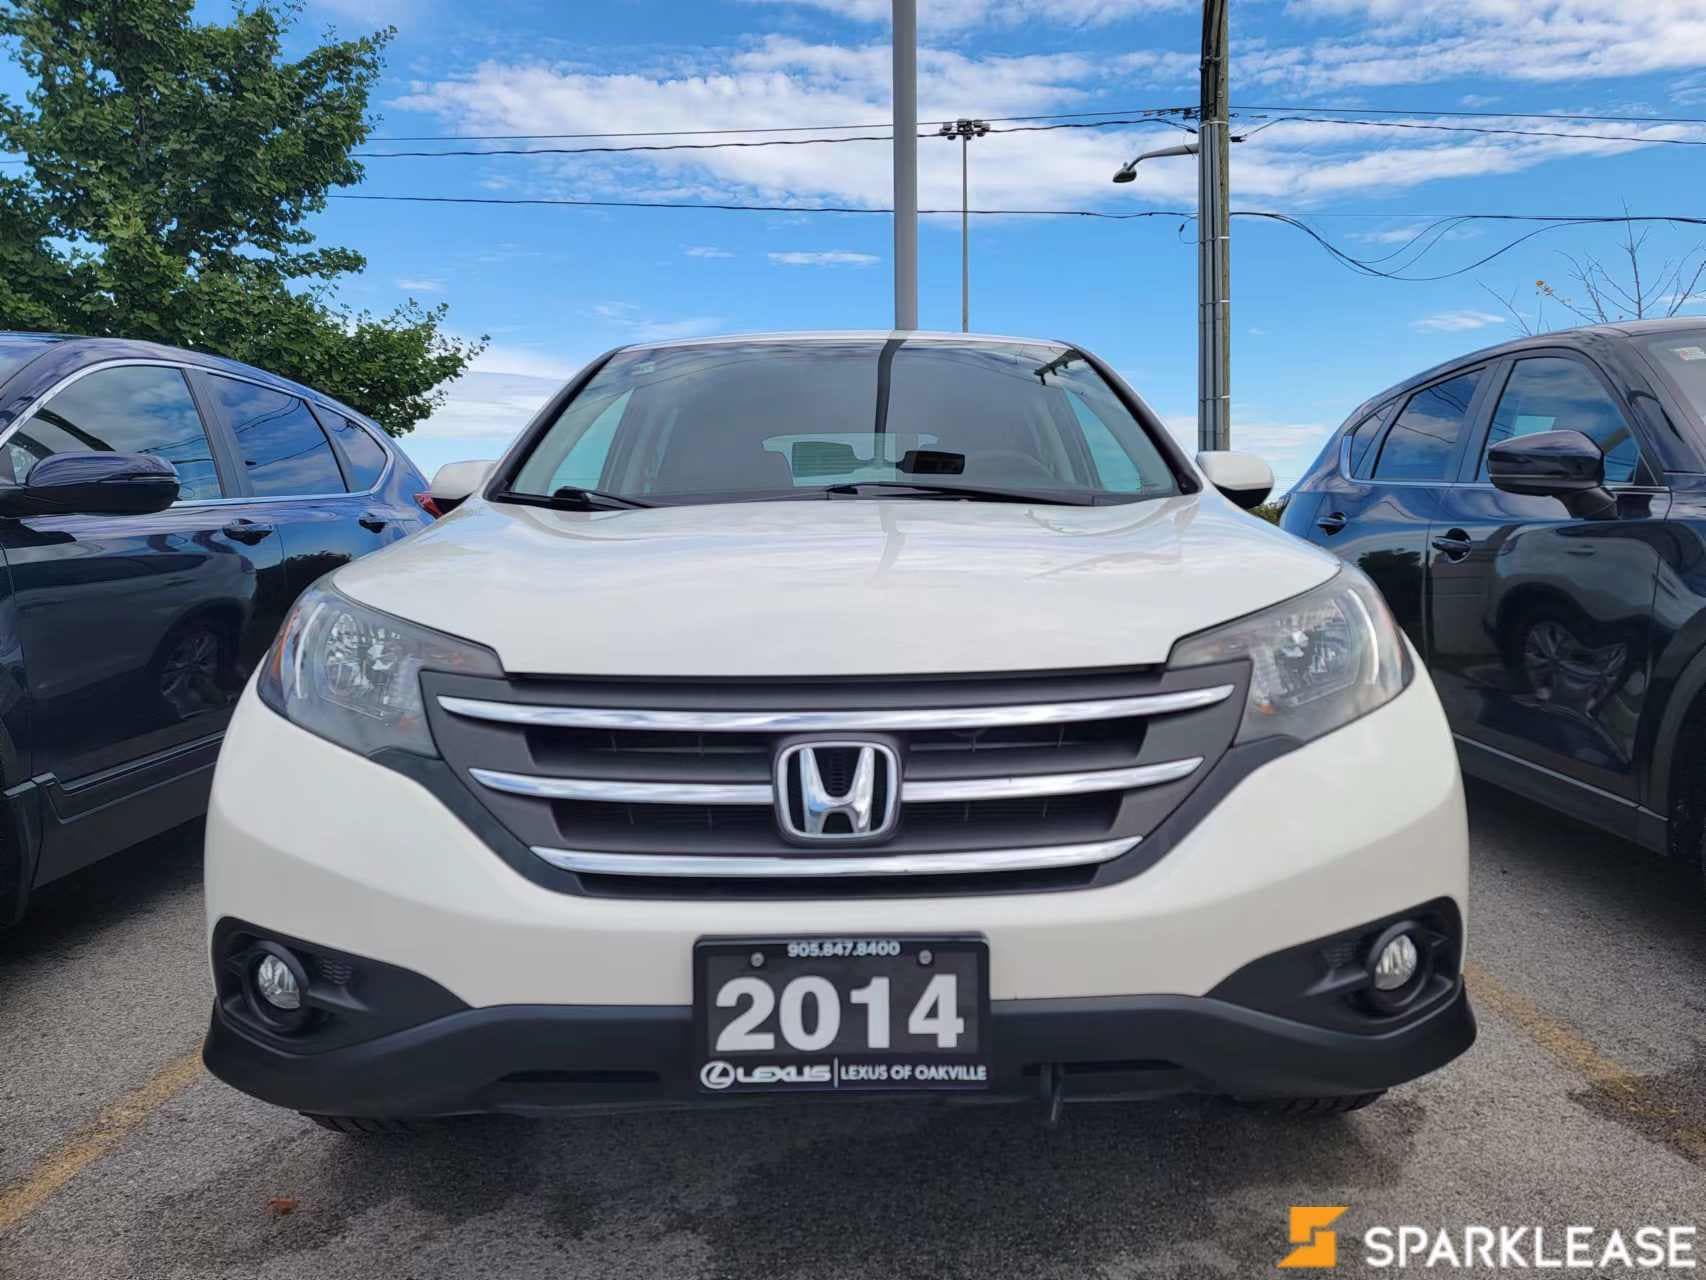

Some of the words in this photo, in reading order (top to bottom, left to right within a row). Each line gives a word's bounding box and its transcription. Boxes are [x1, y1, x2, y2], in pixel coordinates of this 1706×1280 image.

[787, 942, 900, 958] 905.847.8400
[716, 974, 965, 1051] 2014
[735, 1065, 832, 1083] LEXUS
[841, 1065, 888, 1081] LEXUS
[890, 1065, 912, 1080] OF
[915, 1065, 987, 1081] OAKVILLE
